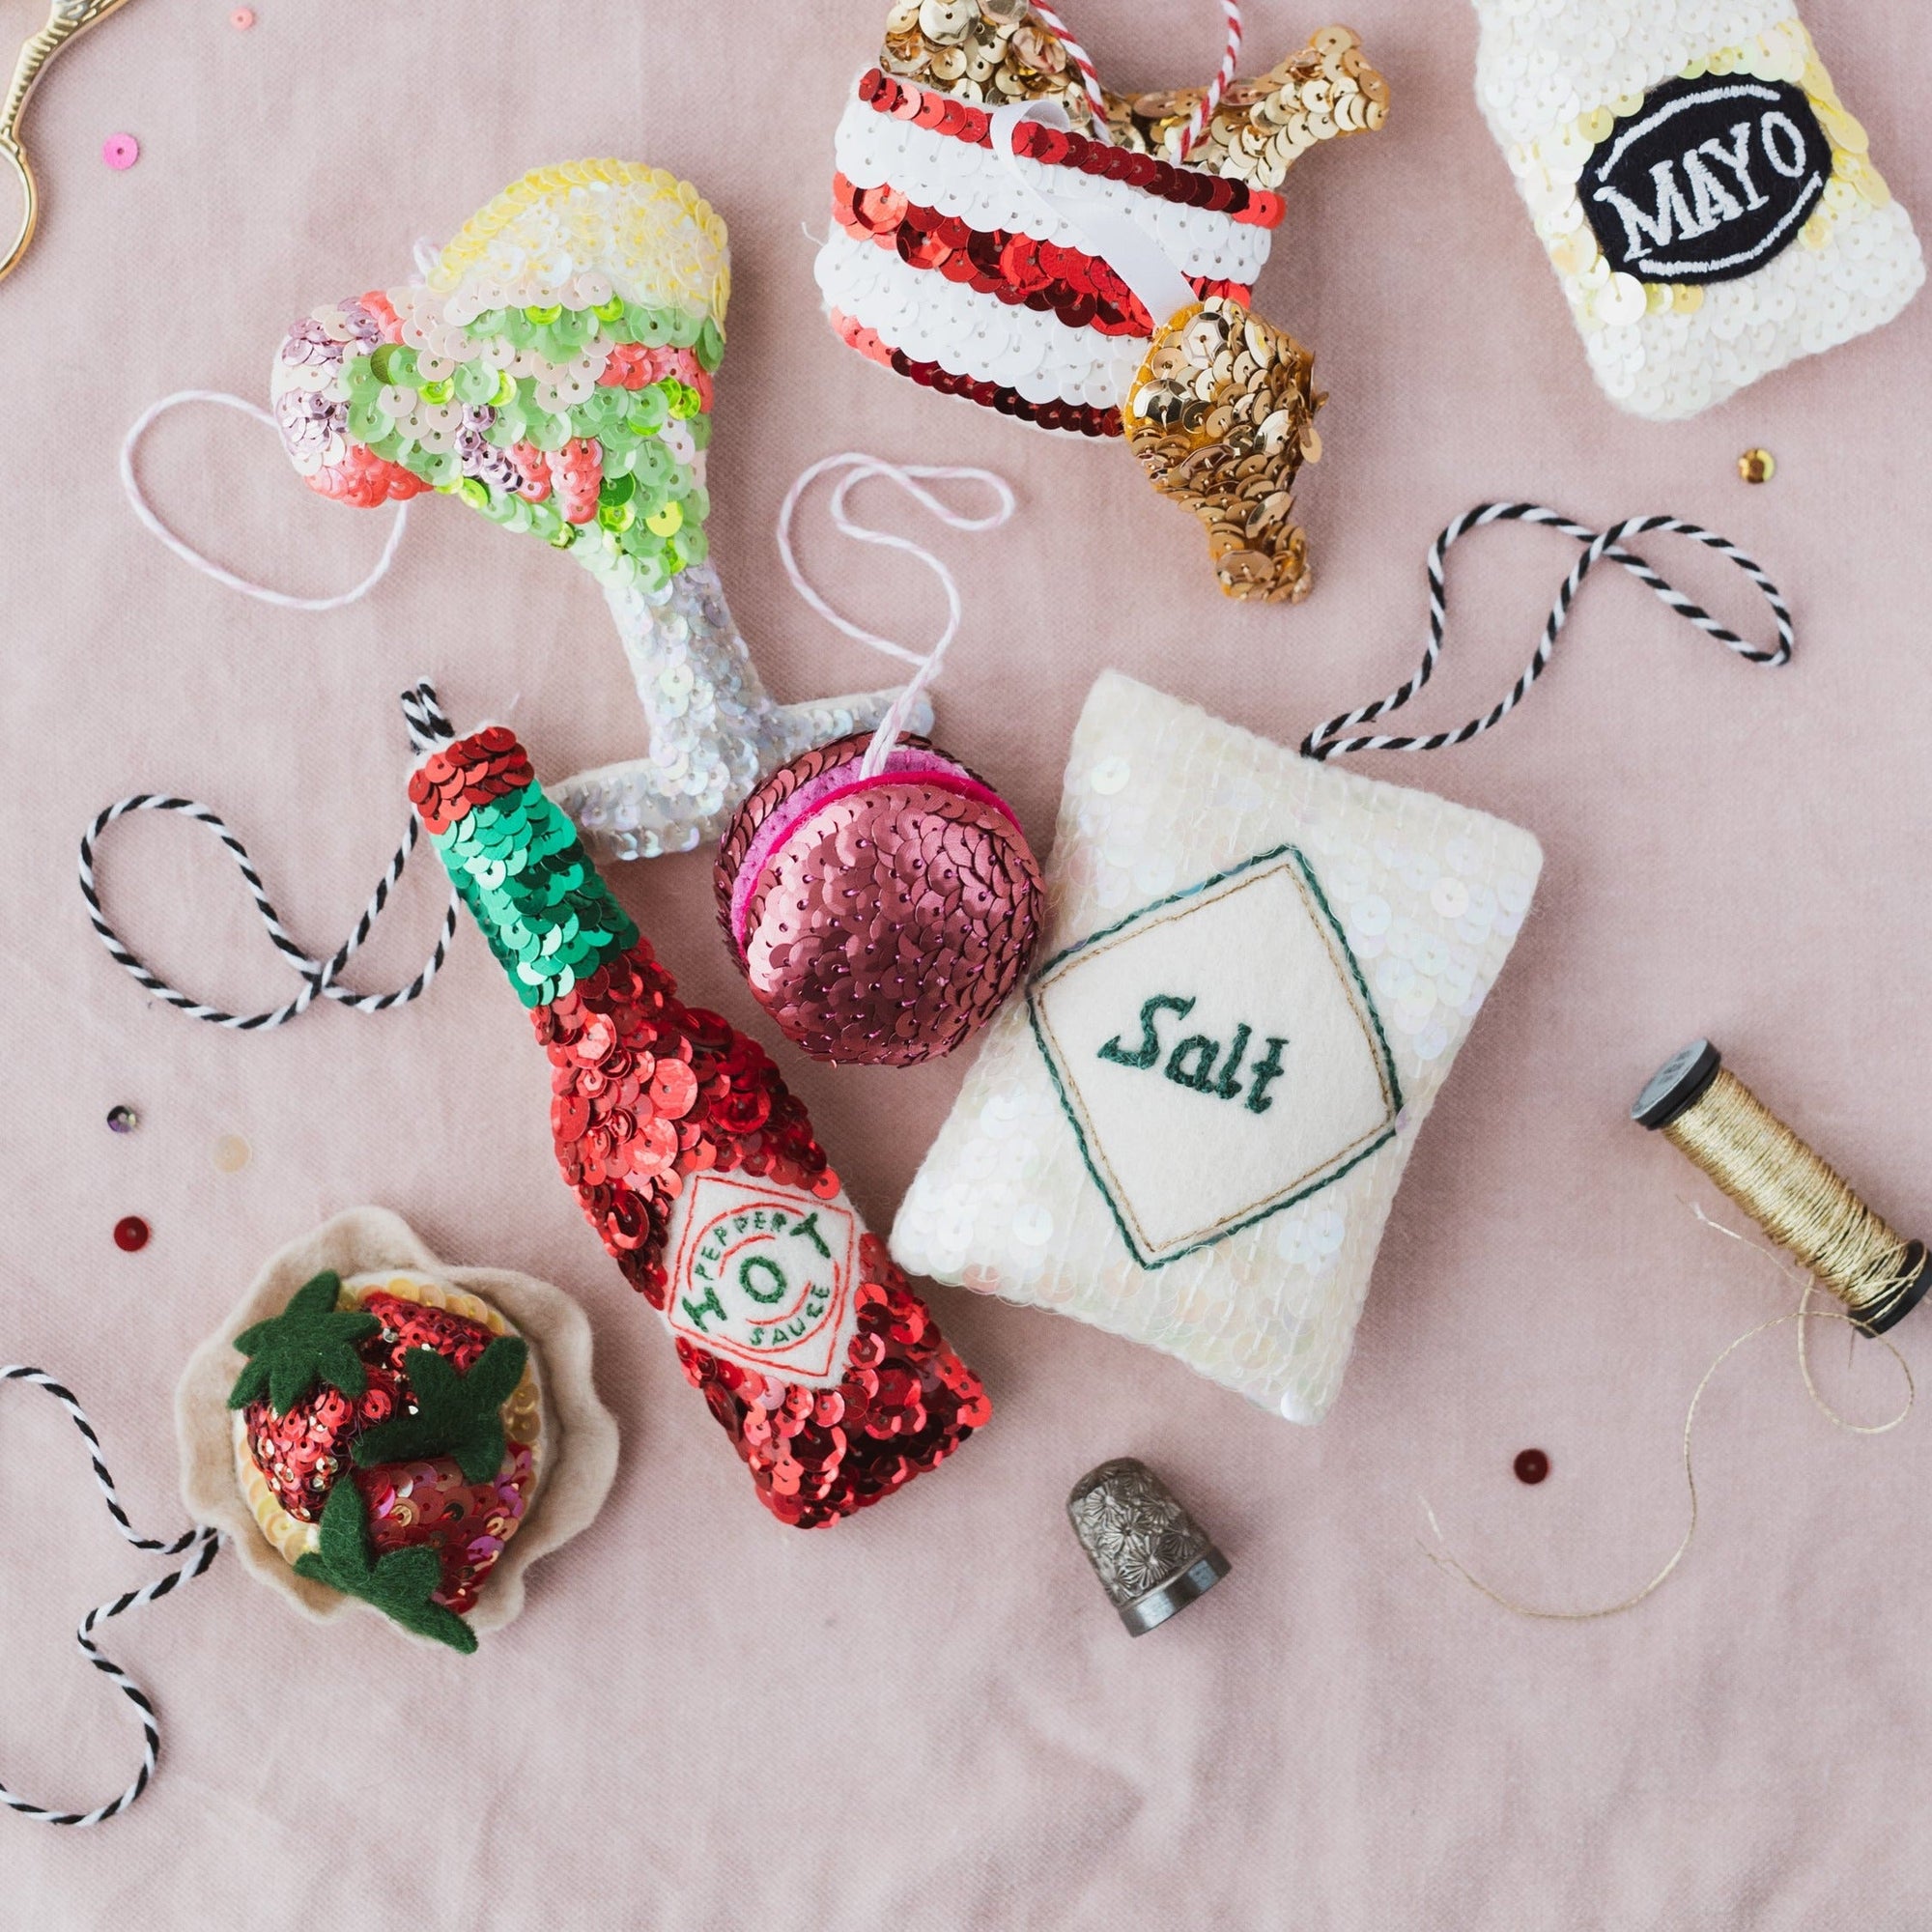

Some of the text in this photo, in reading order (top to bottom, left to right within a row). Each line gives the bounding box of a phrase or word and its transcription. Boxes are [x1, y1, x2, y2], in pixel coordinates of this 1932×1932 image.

[1593, 111, 1806, 262] MAYO
[1097, 994, 1290, 1114] Salt
[682, 1212, 832, 1333] HOT
[694, 1211, 787, 1280] PEPPER
[750, 1285, 830, 1346] SAUCE
